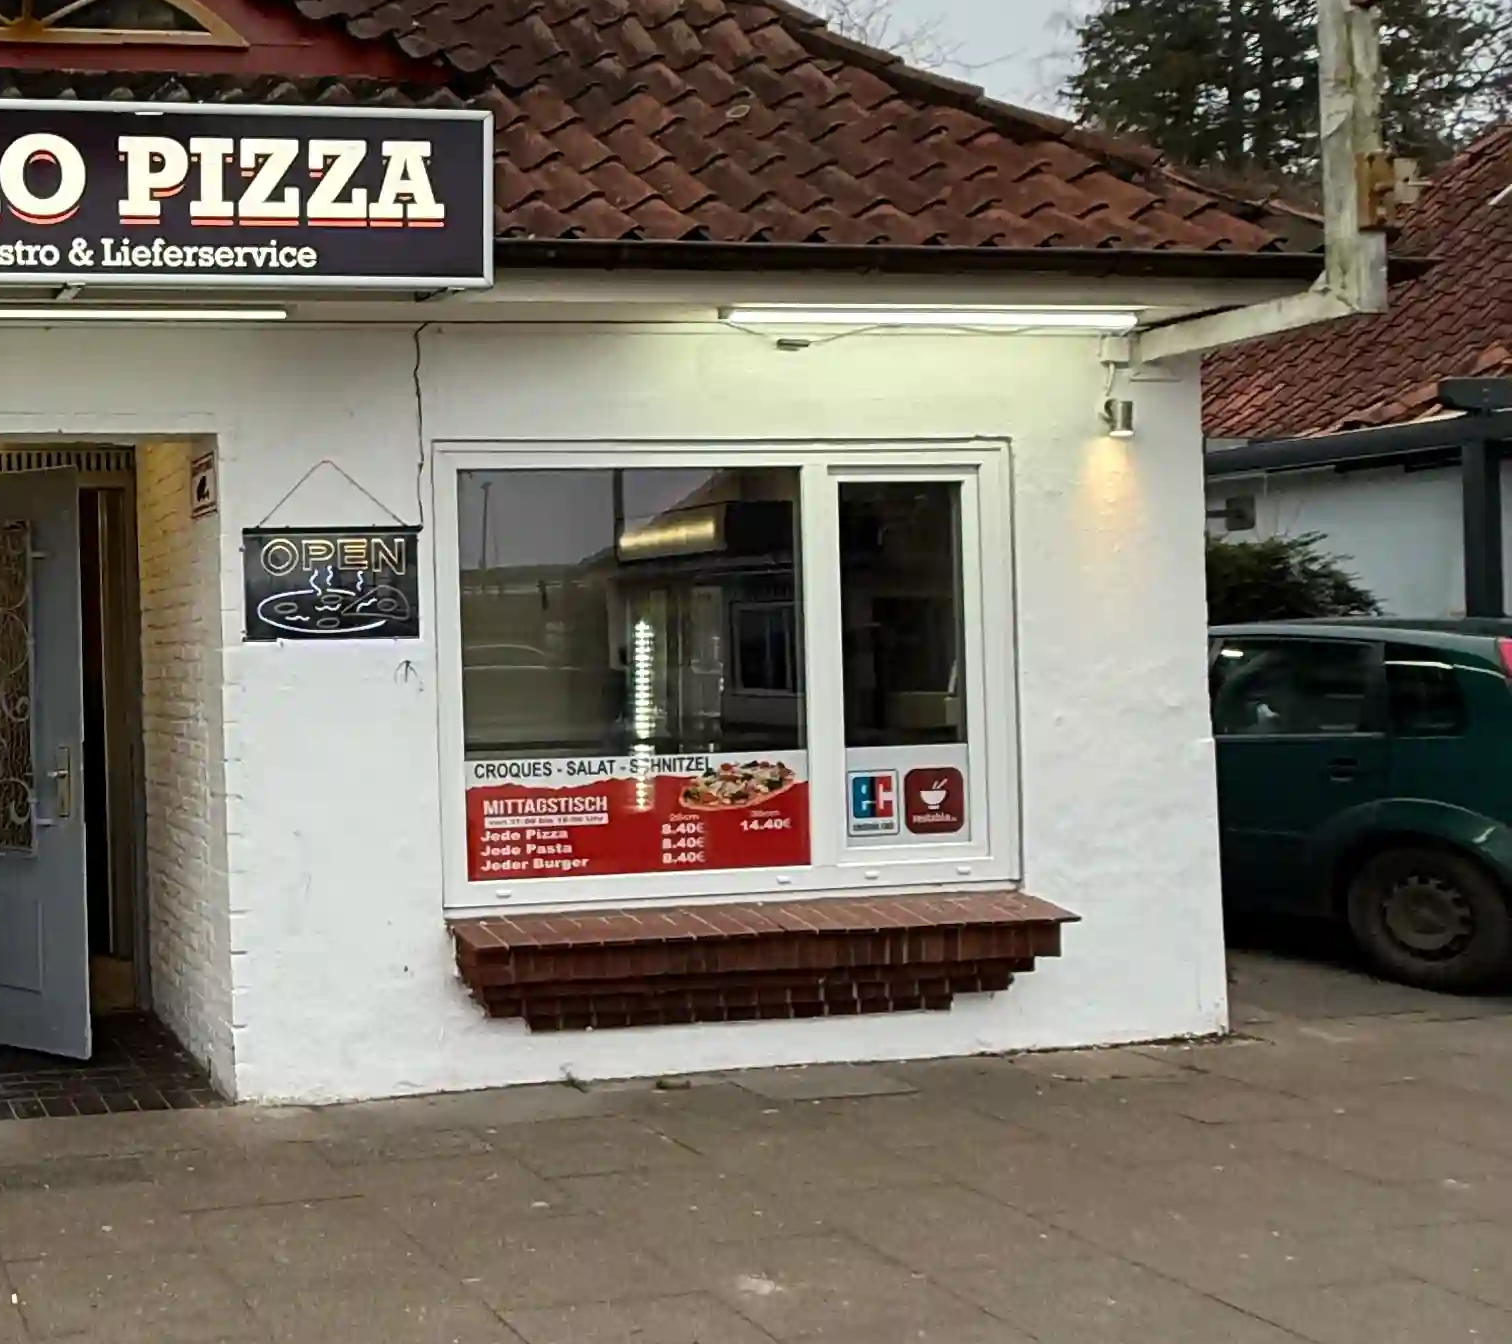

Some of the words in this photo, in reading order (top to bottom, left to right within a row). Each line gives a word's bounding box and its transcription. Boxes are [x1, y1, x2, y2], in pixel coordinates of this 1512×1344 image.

[117, 136, 445, 227] PIZZA
[68, 237, 94, 267] &
[100, 237, 319, 268] Lieferservice
[261, 538, 406, 576] OPEN
[474, 762, 553, 778] CROQUES
[566, 759, 616, 776] SALAT
[629, 756, 713, 774] SHNITZEL
[483, 796, 608, 816] MITTAGSTISCH
[480, 831, 521, 842] Jede
[526, 829, 569, 840] Pizza
[480, 845, 521, 857] Jede
[526, 843, 573, 854] Pasta
[480, 859, 529, 871] Jeder
[533, 857, 590, 871] Burger
